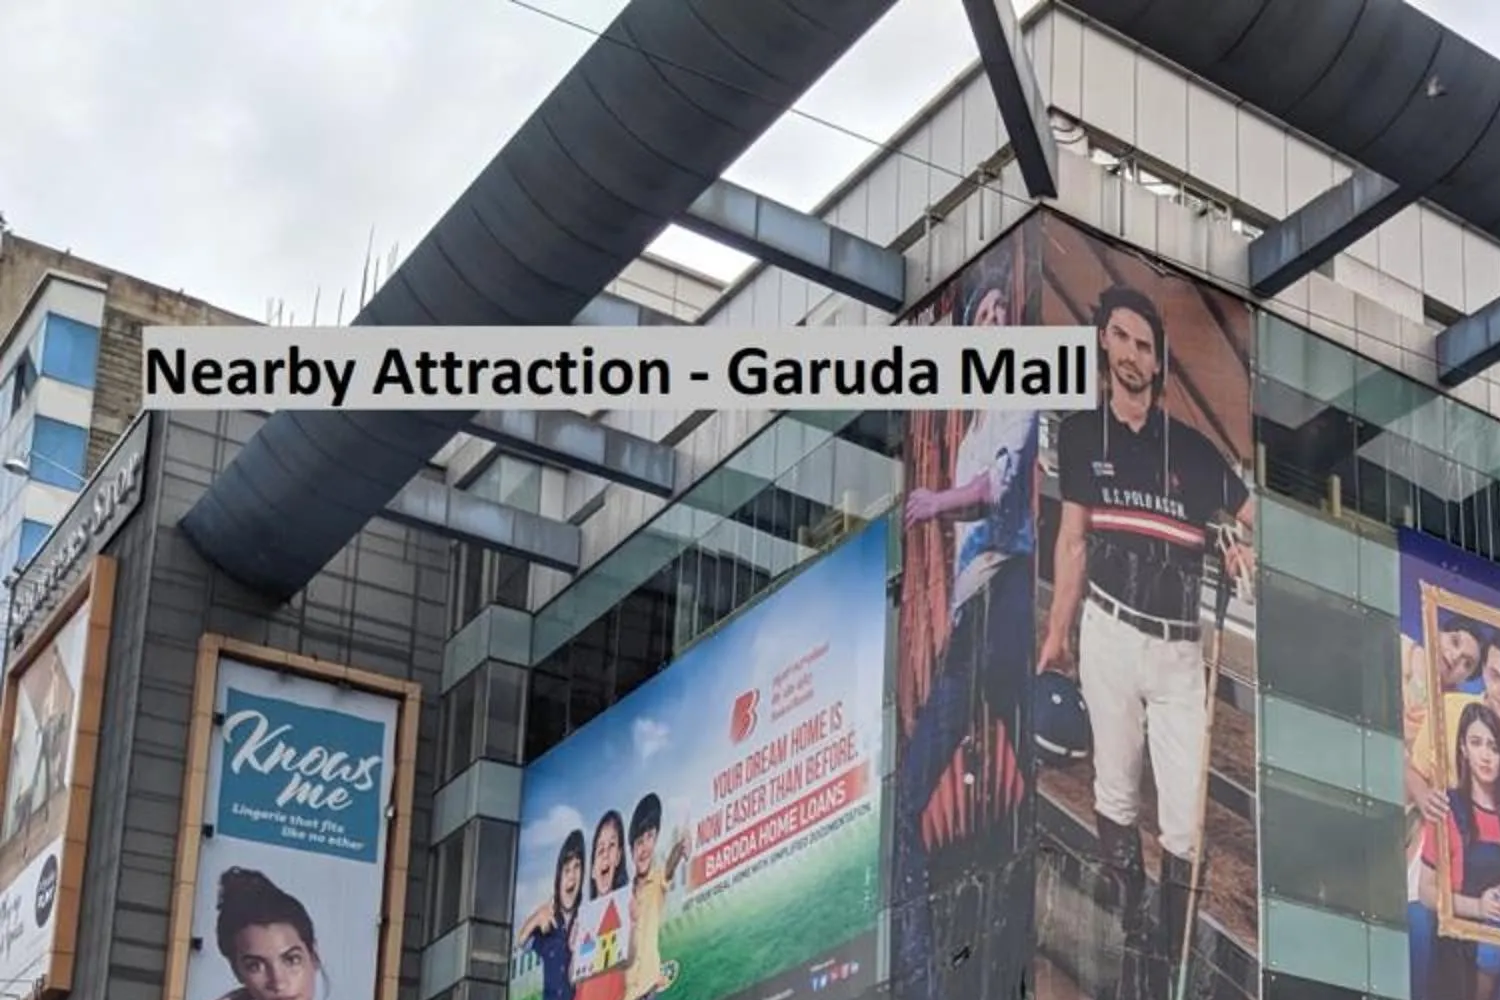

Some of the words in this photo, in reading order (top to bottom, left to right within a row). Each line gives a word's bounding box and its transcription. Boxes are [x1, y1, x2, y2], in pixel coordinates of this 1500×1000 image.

[222, 710, 382, 791] Knows
[276, 772, 353, 811] me
[713, 760, 743, 803] YOUR
[745, 733, 788, 785] DREAM
[790, 712, 827, 756] HOME
[829, 701, 844, 731] IS
[695, 807, 723, 849] NOW
[725, 782, 767, 833] EASIER
[769, 764, 804, 804] THAN
[705, 830, 757, 879] BARODA
[759, 806, 798, 847] HOME
[800, 780, 847, 826] LOANS
